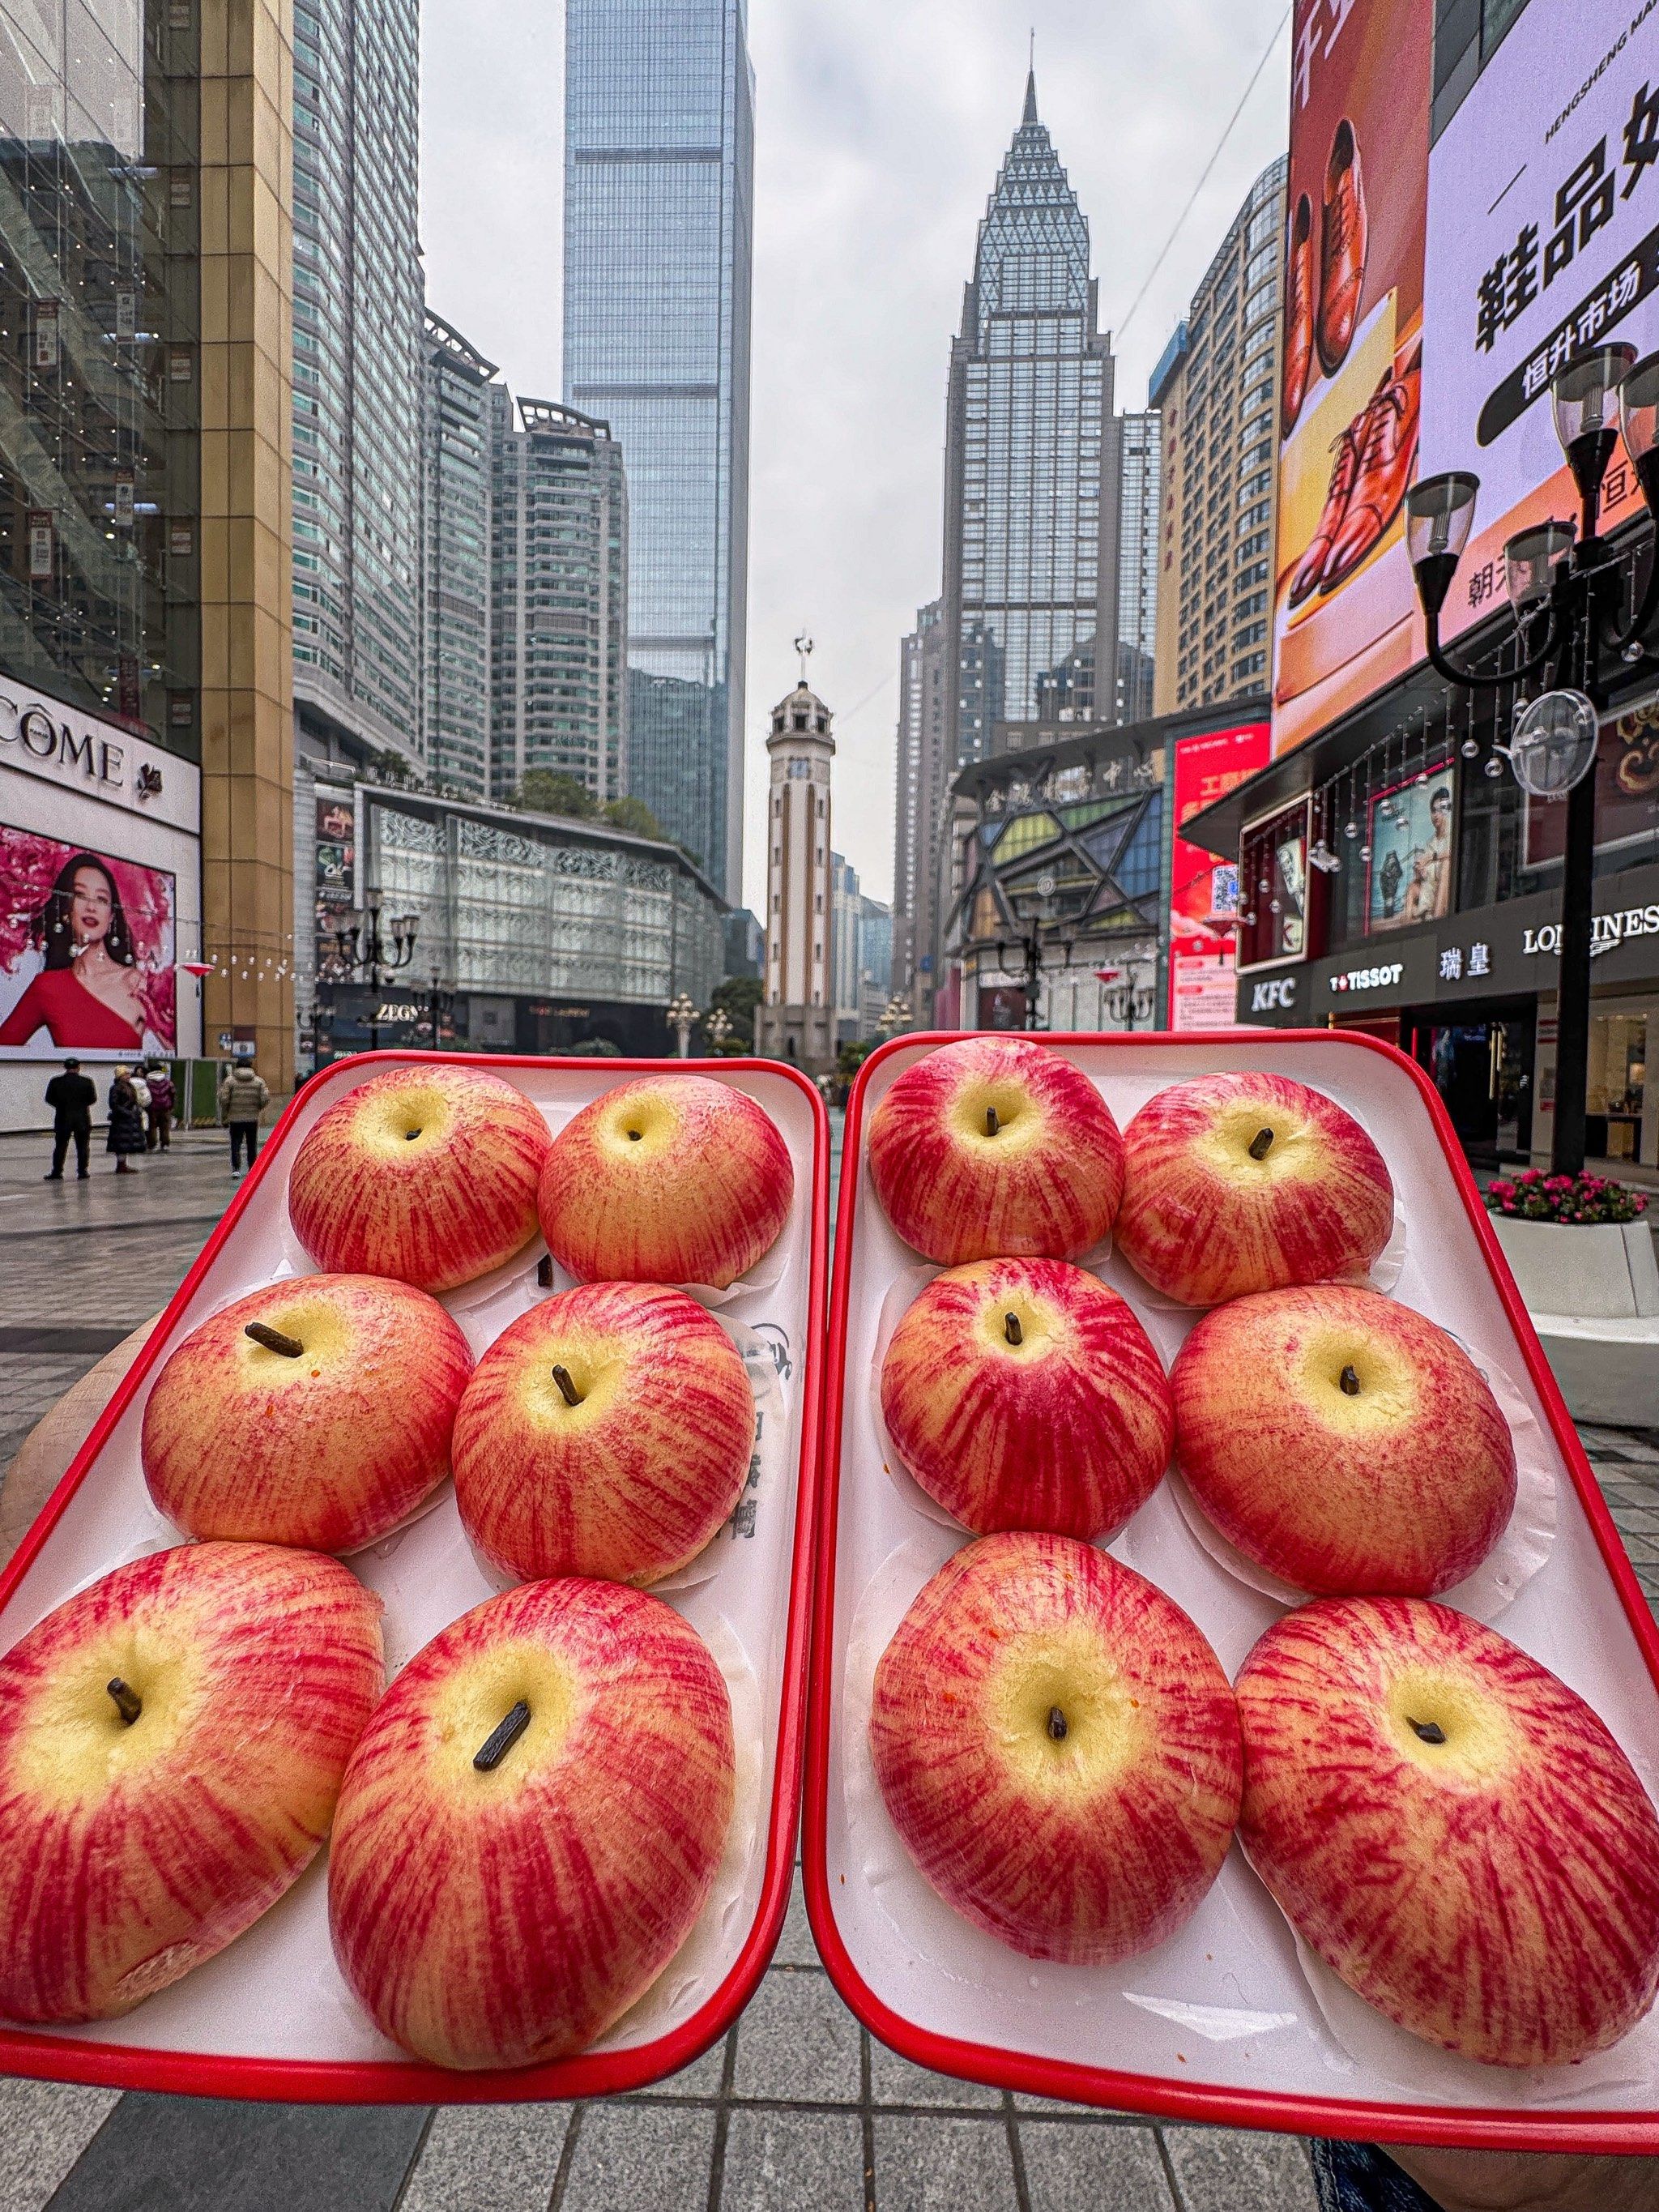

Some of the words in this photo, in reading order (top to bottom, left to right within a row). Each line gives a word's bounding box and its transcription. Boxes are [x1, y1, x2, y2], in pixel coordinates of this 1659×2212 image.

[1544, 31, 1627, 144] HENGSHENG
[1631, 0, 1657, 35] MA
[1252, 977, 1296, 1012] KFC
